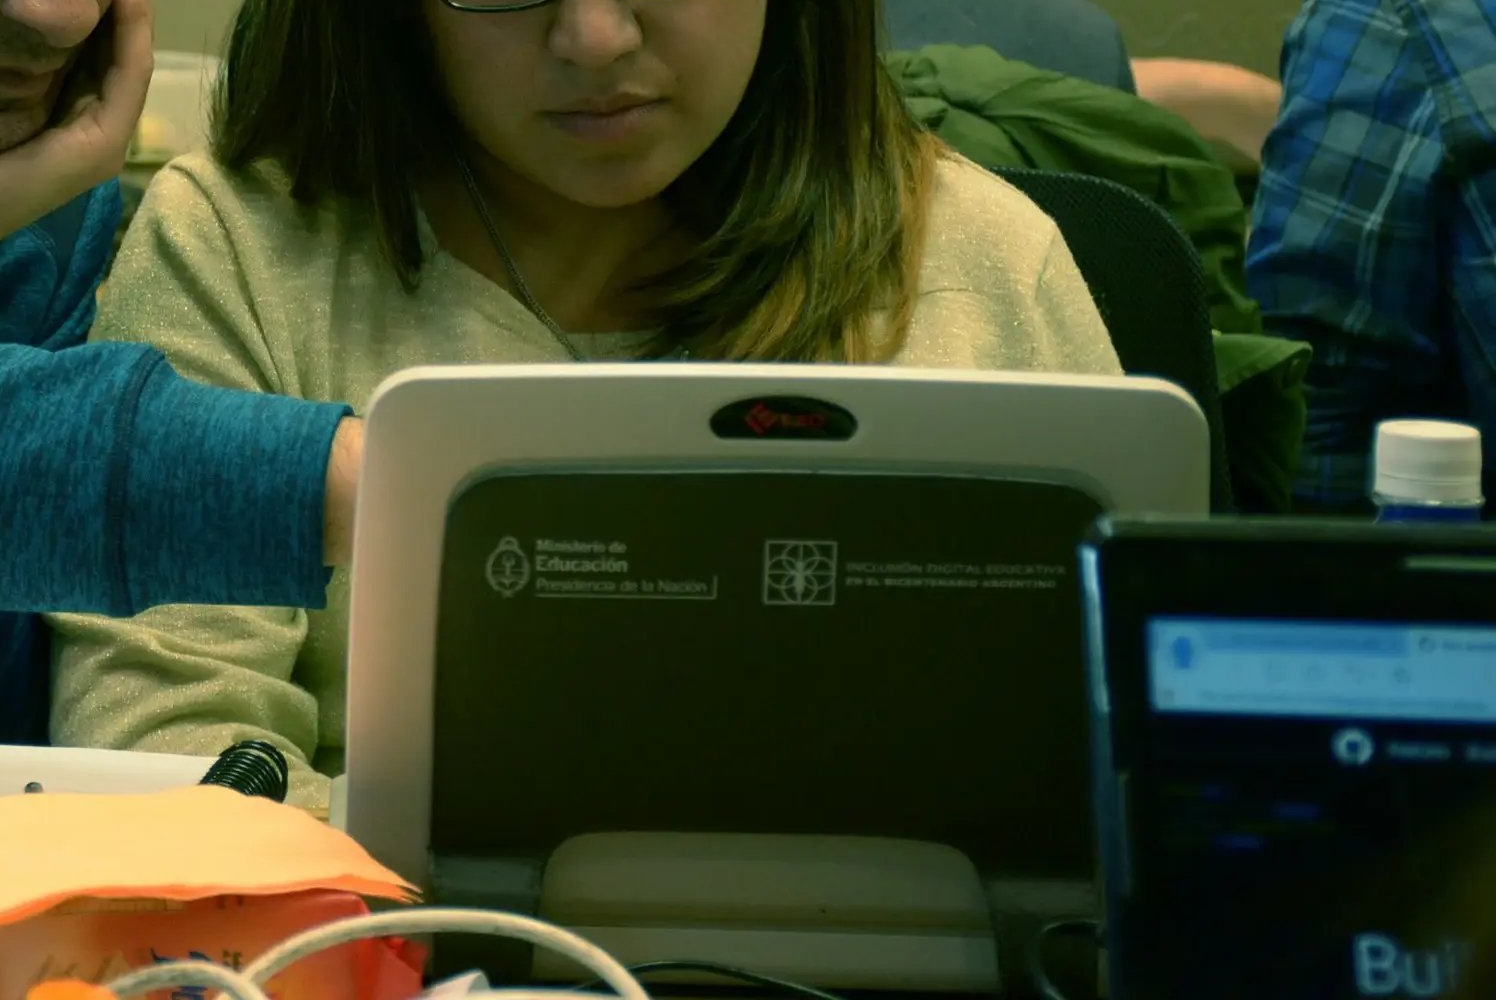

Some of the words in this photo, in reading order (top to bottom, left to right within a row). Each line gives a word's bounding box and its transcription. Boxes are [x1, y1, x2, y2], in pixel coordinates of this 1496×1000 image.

[535, 539, 606, 553] Ministerio
[608, 540, 627, 553] de
[535, 554, 629, 573] Educación
[535, 577, 616, 592] Presidencia
[620, 578, 638, 592] de
[642, 579, 654, 592] la
